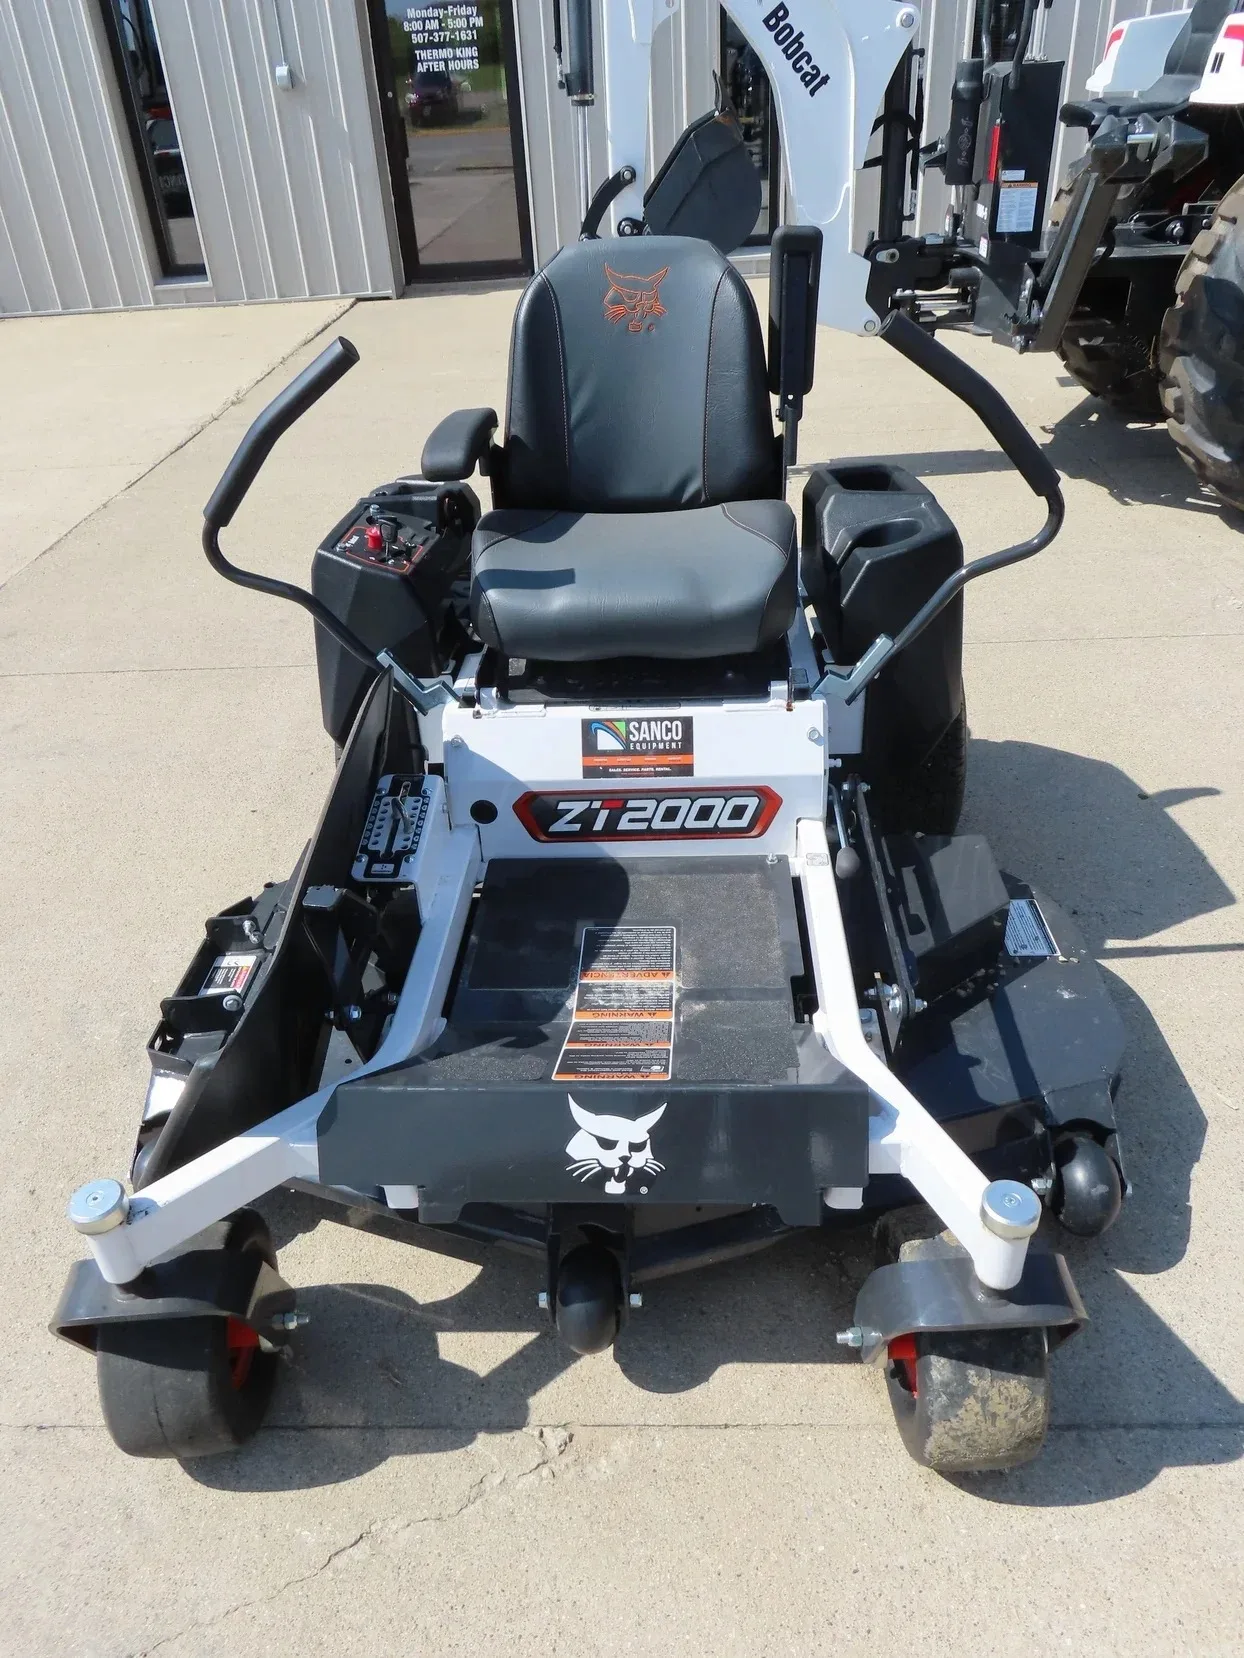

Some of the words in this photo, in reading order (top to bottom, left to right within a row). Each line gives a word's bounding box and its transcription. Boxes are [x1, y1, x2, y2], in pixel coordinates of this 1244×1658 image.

[407, 5, 477, 18] Monday-Friday
[403, 21, 423, 32] 8:00
[424, 19, 439, 30] AM
[447, 18, 468, 29] 5:00
[469, 16, 484, 28] PM
[411, 30, 477, 44] 507-377-1631
[415, 48, 453, 61] THERMO
[455, 47, 478, 59] KING
[762, 1, 831, 98] Bobcat
[416, 61, 446, 73] AFTER
[448, 59, 480, 71] HOURS
[629, 720, 682, 741] SANCO
[630, 741, 682, 750] EQUIPMENT
[548, 796, 760, 833] ZT2000
